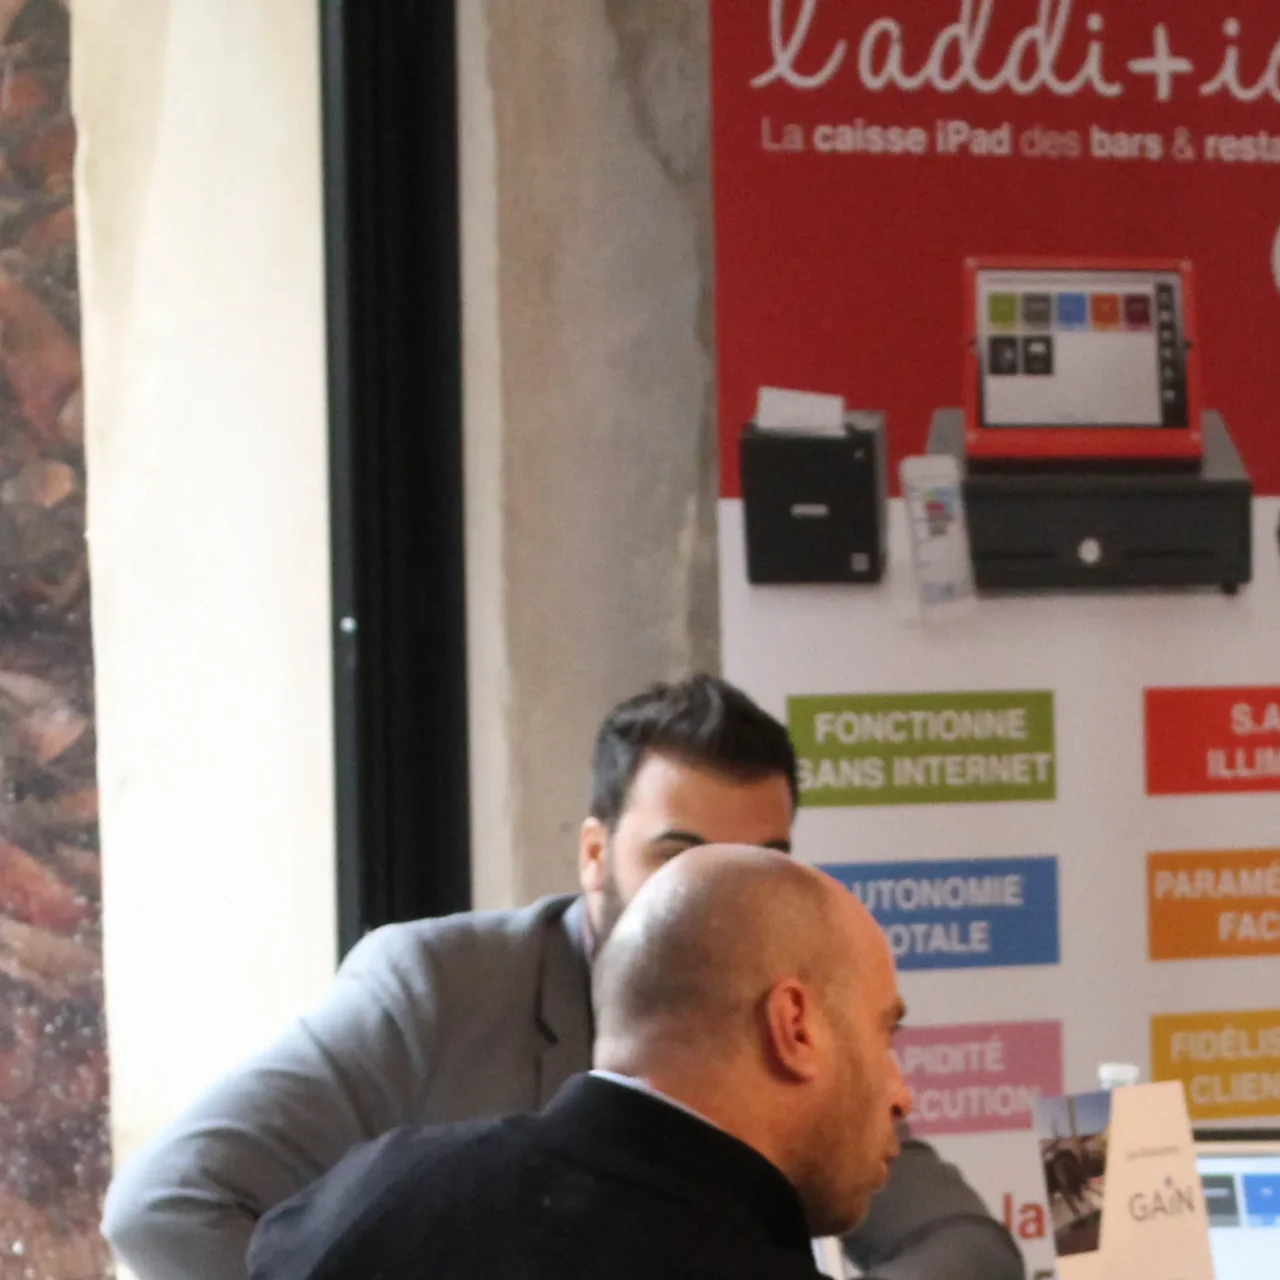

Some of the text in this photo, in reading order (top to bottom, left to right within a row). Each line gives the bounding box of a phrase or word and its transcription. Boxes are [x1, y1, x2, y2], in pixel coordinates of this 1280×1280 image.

[761, 117, 804, 150] La
[813, 118, 927, 154] caisse
[936, 120, 1012, 155] iPad
[1020, 123, 1081, 158] des
[1089, 124, 1163, 159] bars
[1173, 126, 1194, 161] &
[813, 708, 1027, 745] FONCTIONNE
[797, 752, 1051, 791] SANS INTERNET
[852, 874, 1025, 911] UTONOMIE
[886, 920, 989, 955] OTALE
[900, 1032, 1004, 1075] PIDITÉ
